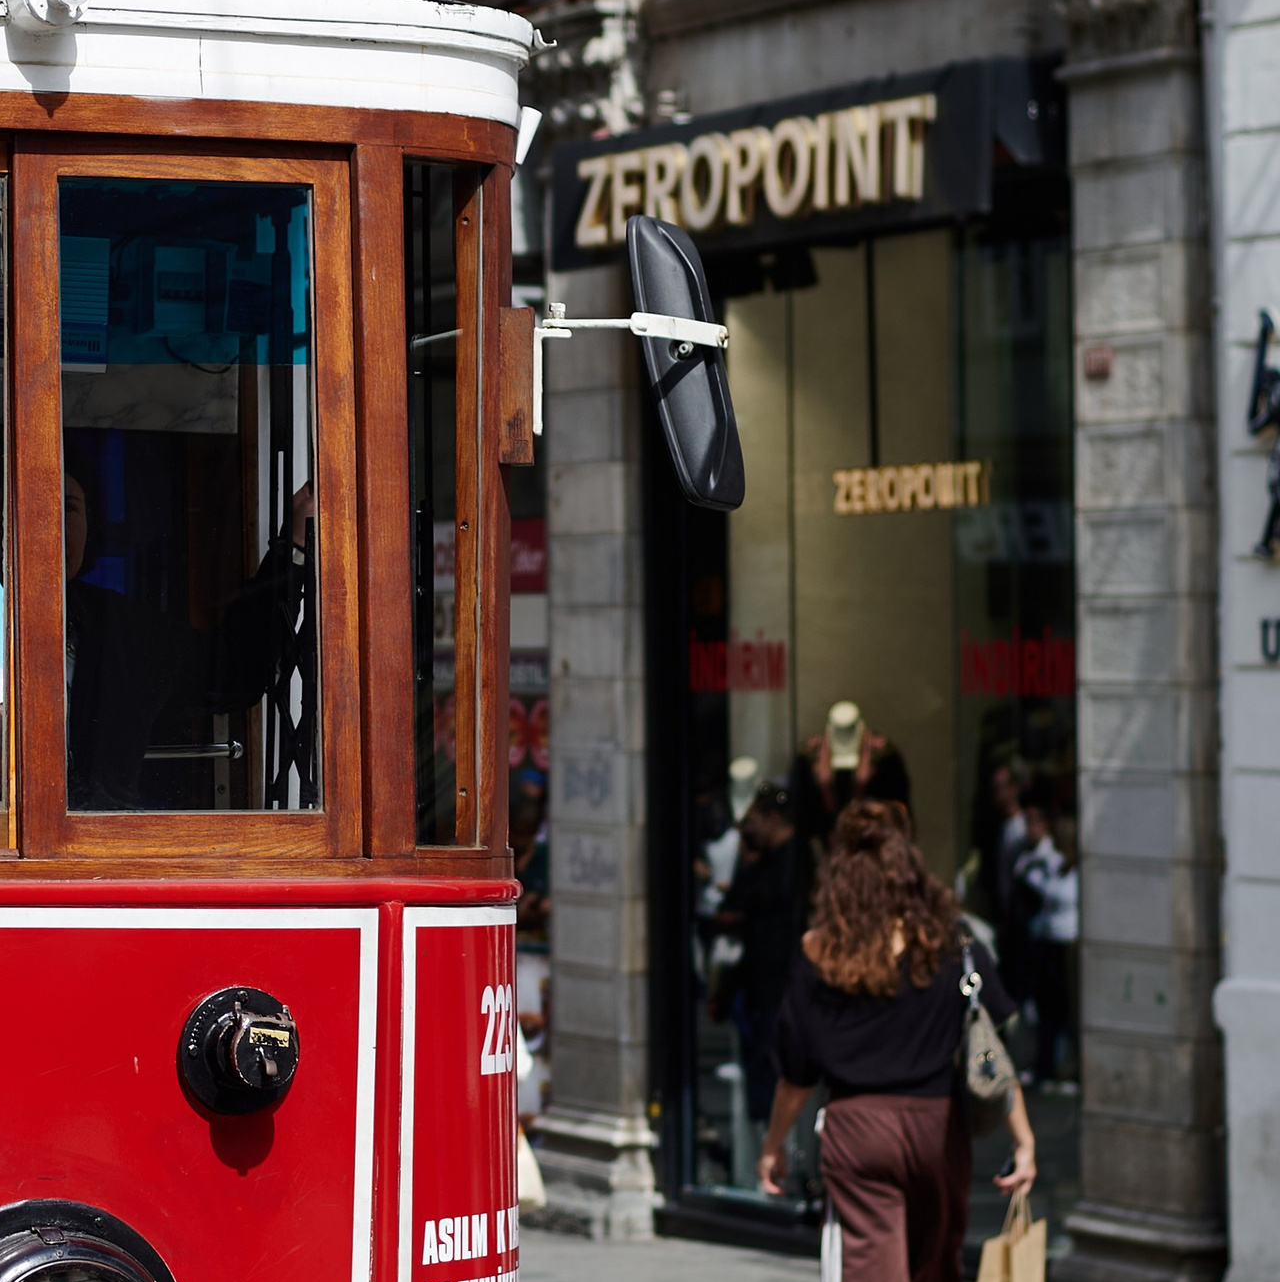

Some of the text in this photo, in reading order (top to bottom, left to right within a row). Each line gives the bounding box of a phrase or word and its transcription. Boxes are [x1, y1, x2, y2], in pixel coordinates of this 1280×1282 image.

[575, 93, 937, 248] ZEROPOINT
[833, 460, 984, 514] ZEROPOINT
[481, 983, 513, 1075] 223
